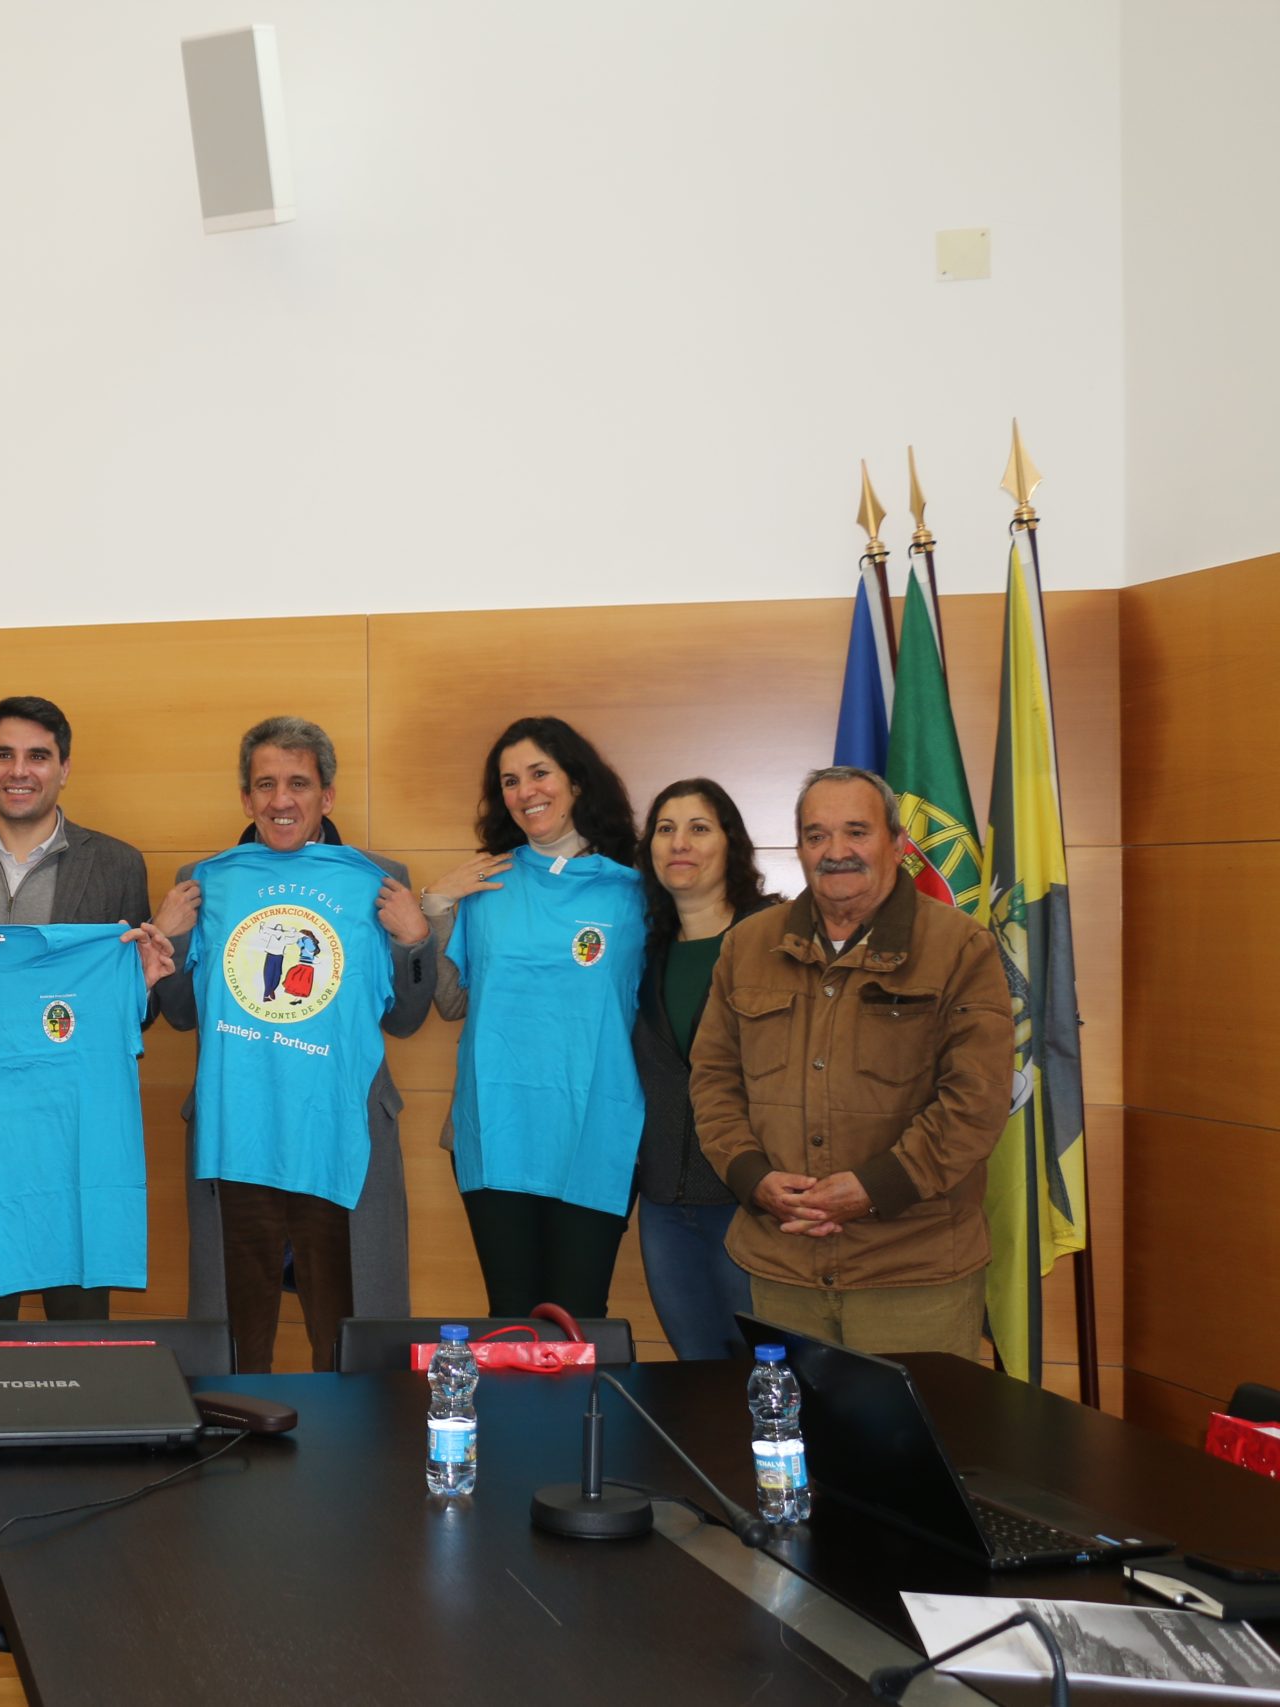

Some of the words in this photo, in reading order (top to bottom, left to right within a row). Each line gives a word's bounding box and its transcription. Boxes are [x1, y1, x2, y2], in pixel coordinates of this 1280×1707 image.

[258, 883, 343, 914] FESTIFOLK
[227, 921, 252, 958] FESTIVAL
[249, 907, 319, 926] INTERNACIONAL
[318, 922, 331, 936] DE
[328, 932, 342, 981] FOLCLORE
[227, 967, 248, 1003] CIDADE
[248, 1003, 262, 1014] DE
[264, 1010, 297, 1020] PONTE
[301, 1005, 314, 1016] DE
[316, 988, 333, 1006] SOR
[216, 1020, 261, 1041] Aentejo
[272, 1031, 330, 1057] Portugal
